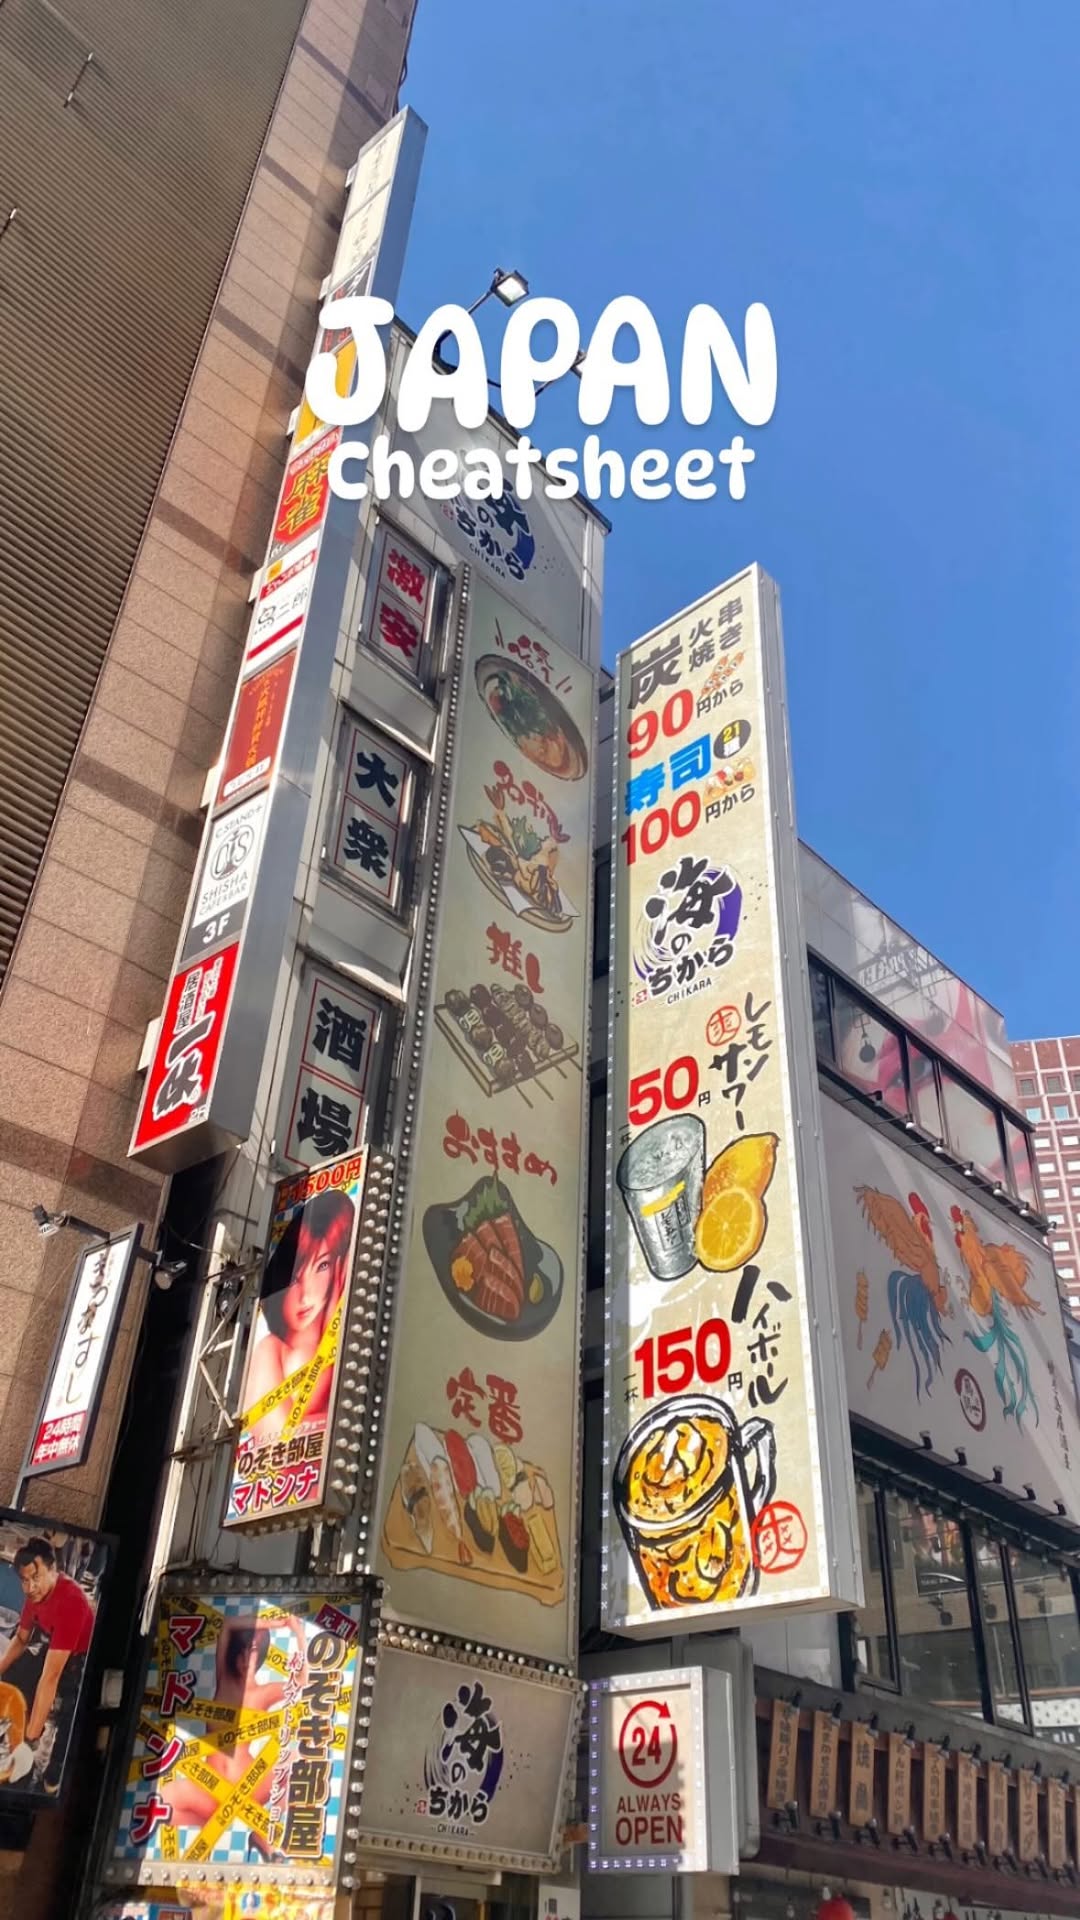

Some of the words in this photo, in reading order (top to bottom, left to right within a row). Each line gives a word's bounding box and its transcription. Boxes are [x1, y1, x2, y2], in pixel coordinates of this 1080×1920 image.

[624, 733, 711, 816] 寿司
[202, 871, 248, 905] SHISHA
[202, 912, 230, 944] 3F
[667, 977, 712, 1004] CHIKARA
[731, 1264, 793, 1408] ハイボール
[446, 1366, 524, 1445] 定番
[238, 1431, 326, 1476] のぞき部屋
[234, 1466, 319, 1514] マドンナ
[131, 1614, 204, 1842] マドンナ
[281, 1631, 346, 1858] のぞき部屋
[632, 1726, 662, 1766] 24
[616, 1793, 681, 1814] ALWAYS
[616, 1815, 683, 1846] OPEN
